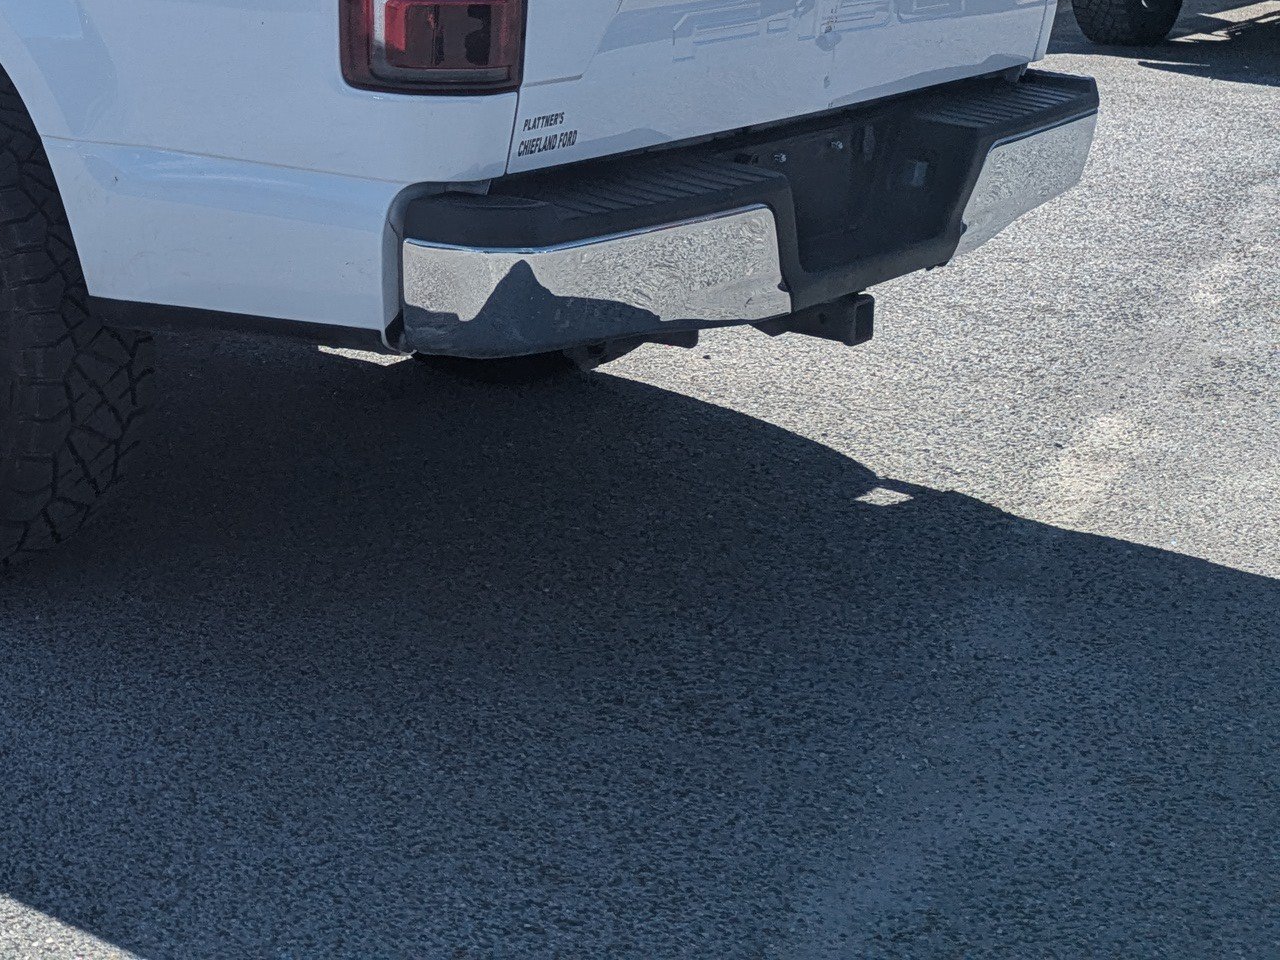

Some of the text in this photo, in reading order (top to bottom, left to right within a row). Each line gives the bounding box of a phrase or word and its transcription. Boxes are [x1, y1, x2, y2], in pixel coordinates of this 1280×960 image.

[523, 111, 566, 132] PLATTNER'S
[517, 129, 579, 157] CHIEFLAND FORD
